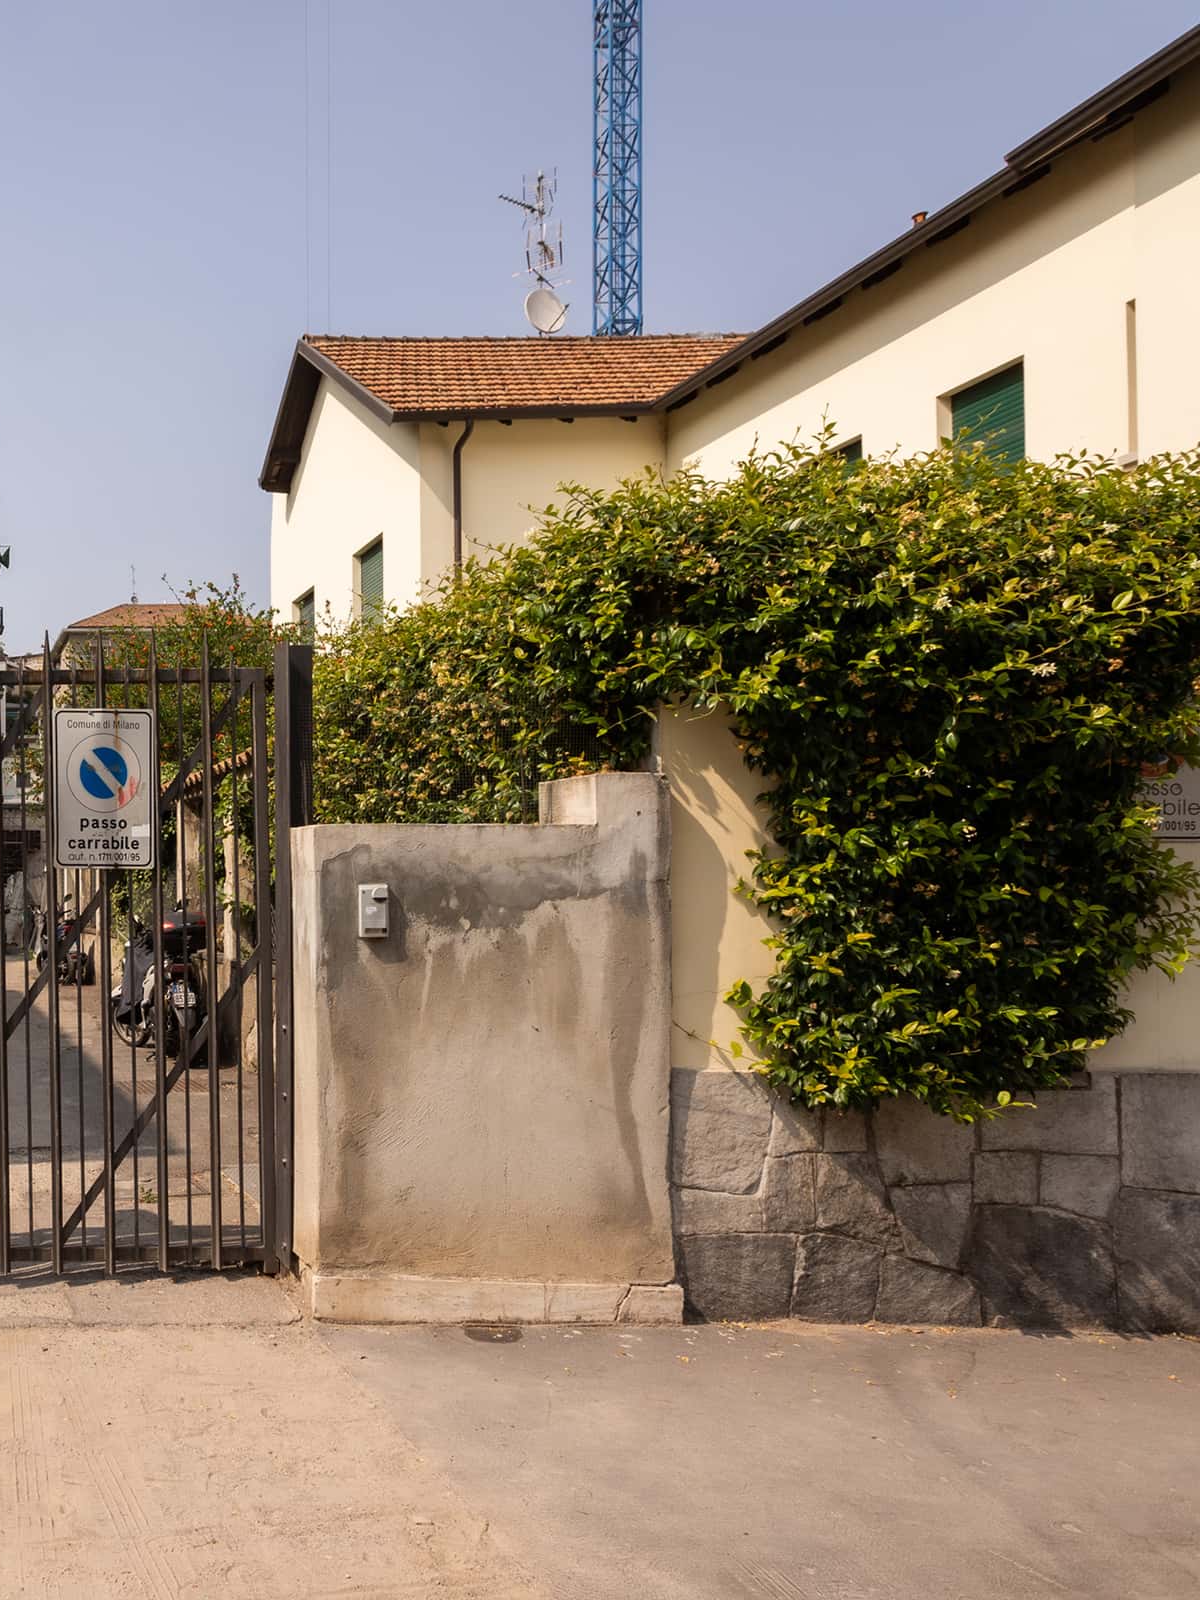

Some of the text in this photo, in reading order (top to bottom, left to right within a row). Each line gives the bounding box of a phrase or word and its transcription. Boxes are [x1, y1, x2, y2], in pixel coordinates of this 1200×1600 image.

[67, 719, 140, 730] Comune di Milano
[80, 818, 128, 831] passo
[68, 836, 140, 850] carrabile
